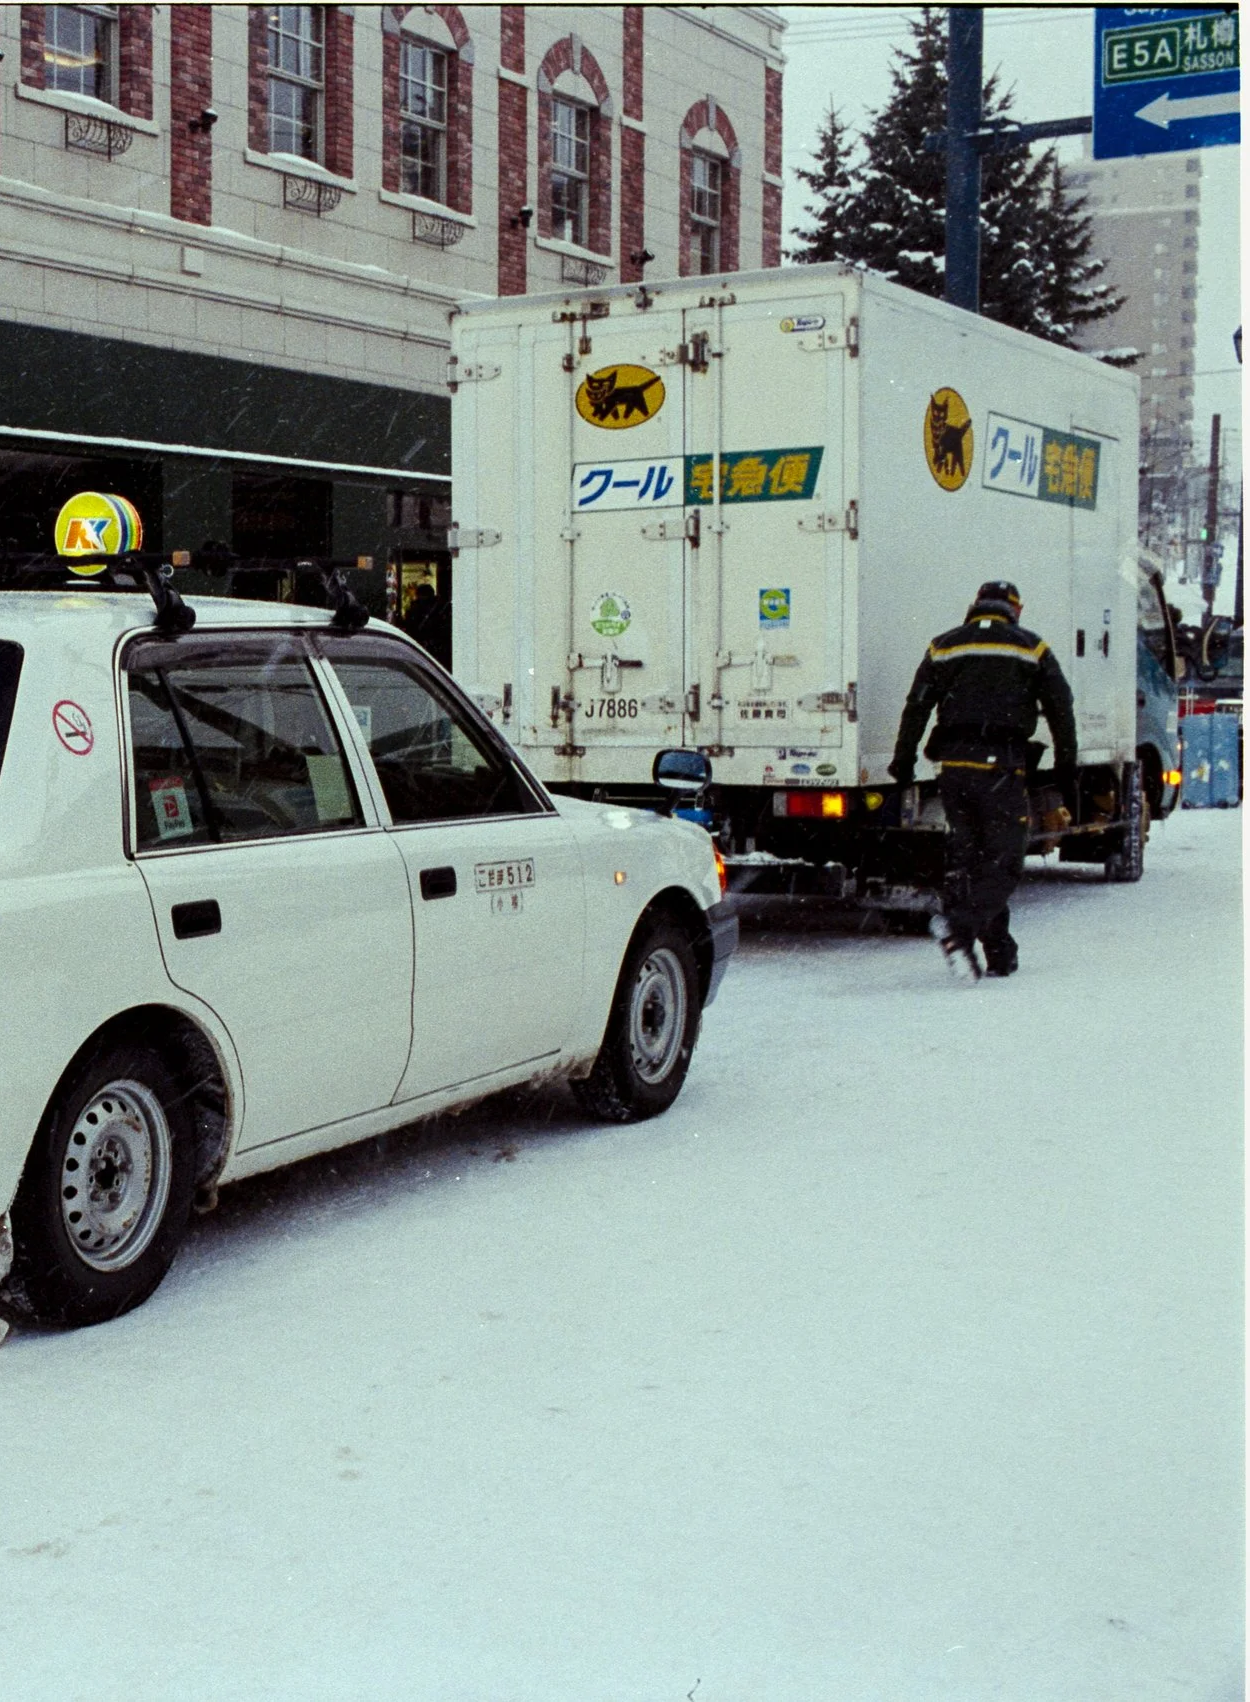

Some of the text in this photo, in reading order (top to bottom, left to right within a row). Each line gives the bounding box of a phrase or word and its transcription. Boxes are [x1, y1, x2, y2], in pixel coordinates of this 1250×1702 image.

[1112, 37, 1172, 70] E5A
[1183, 50, 1235, 72] SASSON
[578, 453, 811, 507] クール 宅急便
[990, 426, 1096, 499] クール 宅急便
